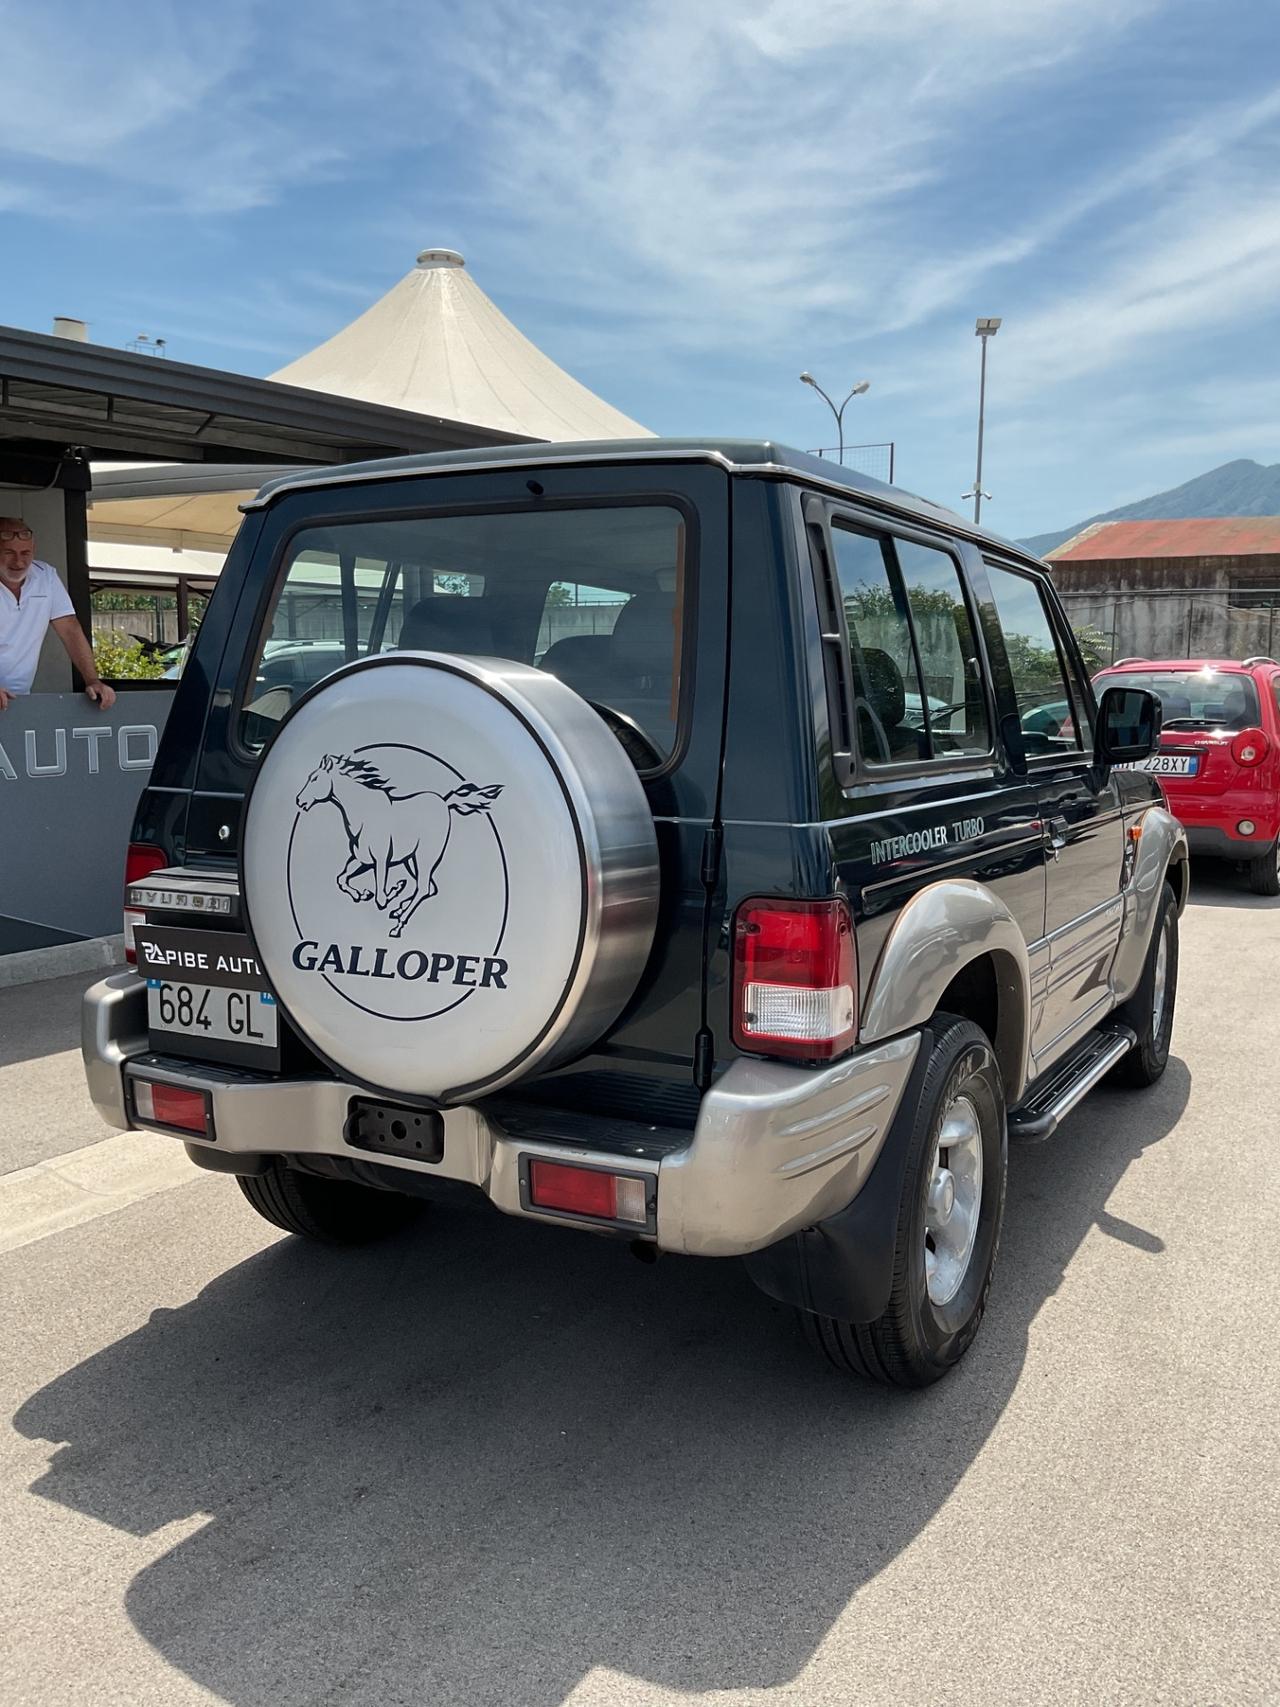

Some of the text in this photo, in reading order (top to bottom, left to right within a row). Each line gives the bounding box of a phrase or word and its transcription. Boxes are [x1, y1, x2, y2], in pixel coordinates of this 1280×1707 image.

[870, 816, 985, 865] INTERCOOLER TURBO
[165, 950, 209, 969] PIBE
[292, 940, 509, 989] GALLOPER
[159, 983, 264, 1039] 684 GL
